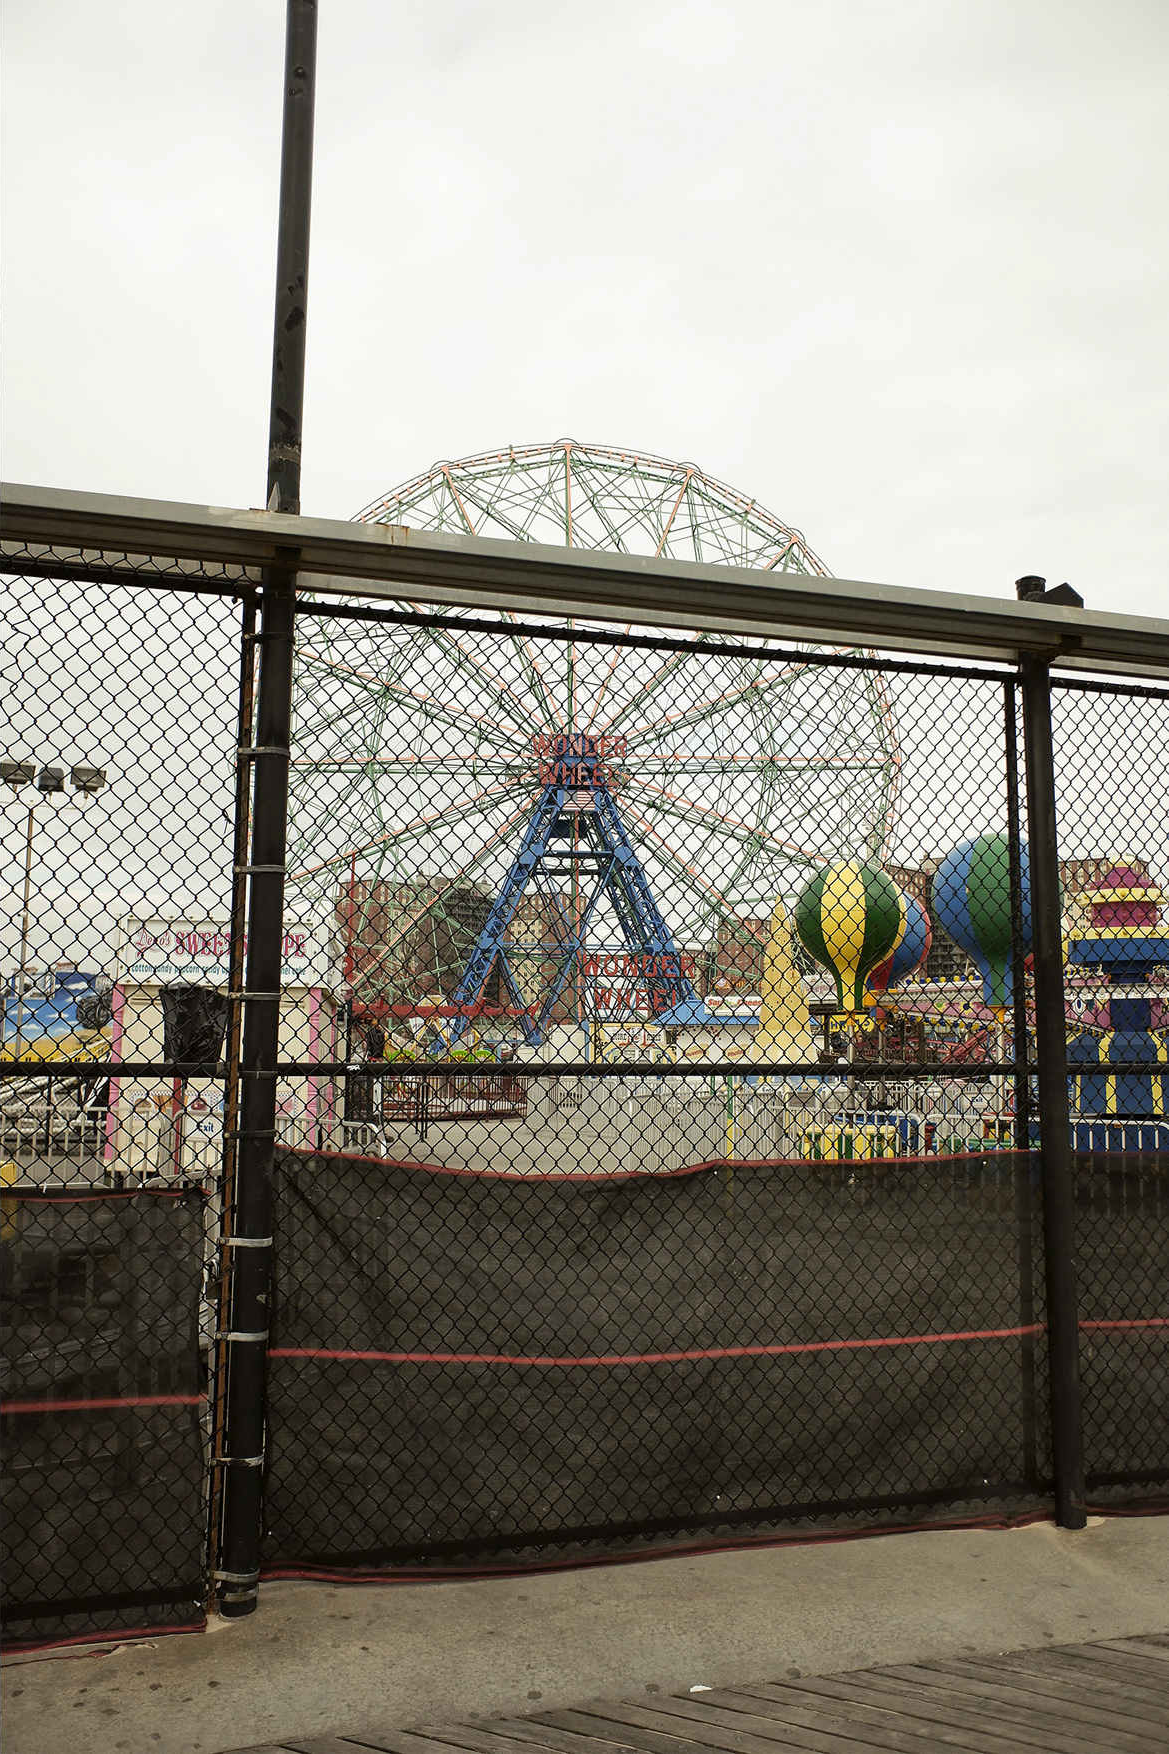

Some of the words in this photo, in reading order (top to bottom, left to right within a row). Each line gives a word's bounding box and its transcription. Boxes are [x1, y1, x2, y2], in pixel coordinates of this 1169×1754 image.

[532, 734, 627, 757] WONDER
[539, 761, 622, 786] WHEEL
[135, 928, 171, 950] Deo's
[131, 964, 152, 973] cotton
[154, 964, 172, 976] andy
[582, 954, 695, 978] WONDER
[595, 988, 676, 1010] WHEEL
[737, 998, 762, 1007] Chees
[727, 1048, 746, 1057] Photo
[199, 1121, 214, 1132] Exit
